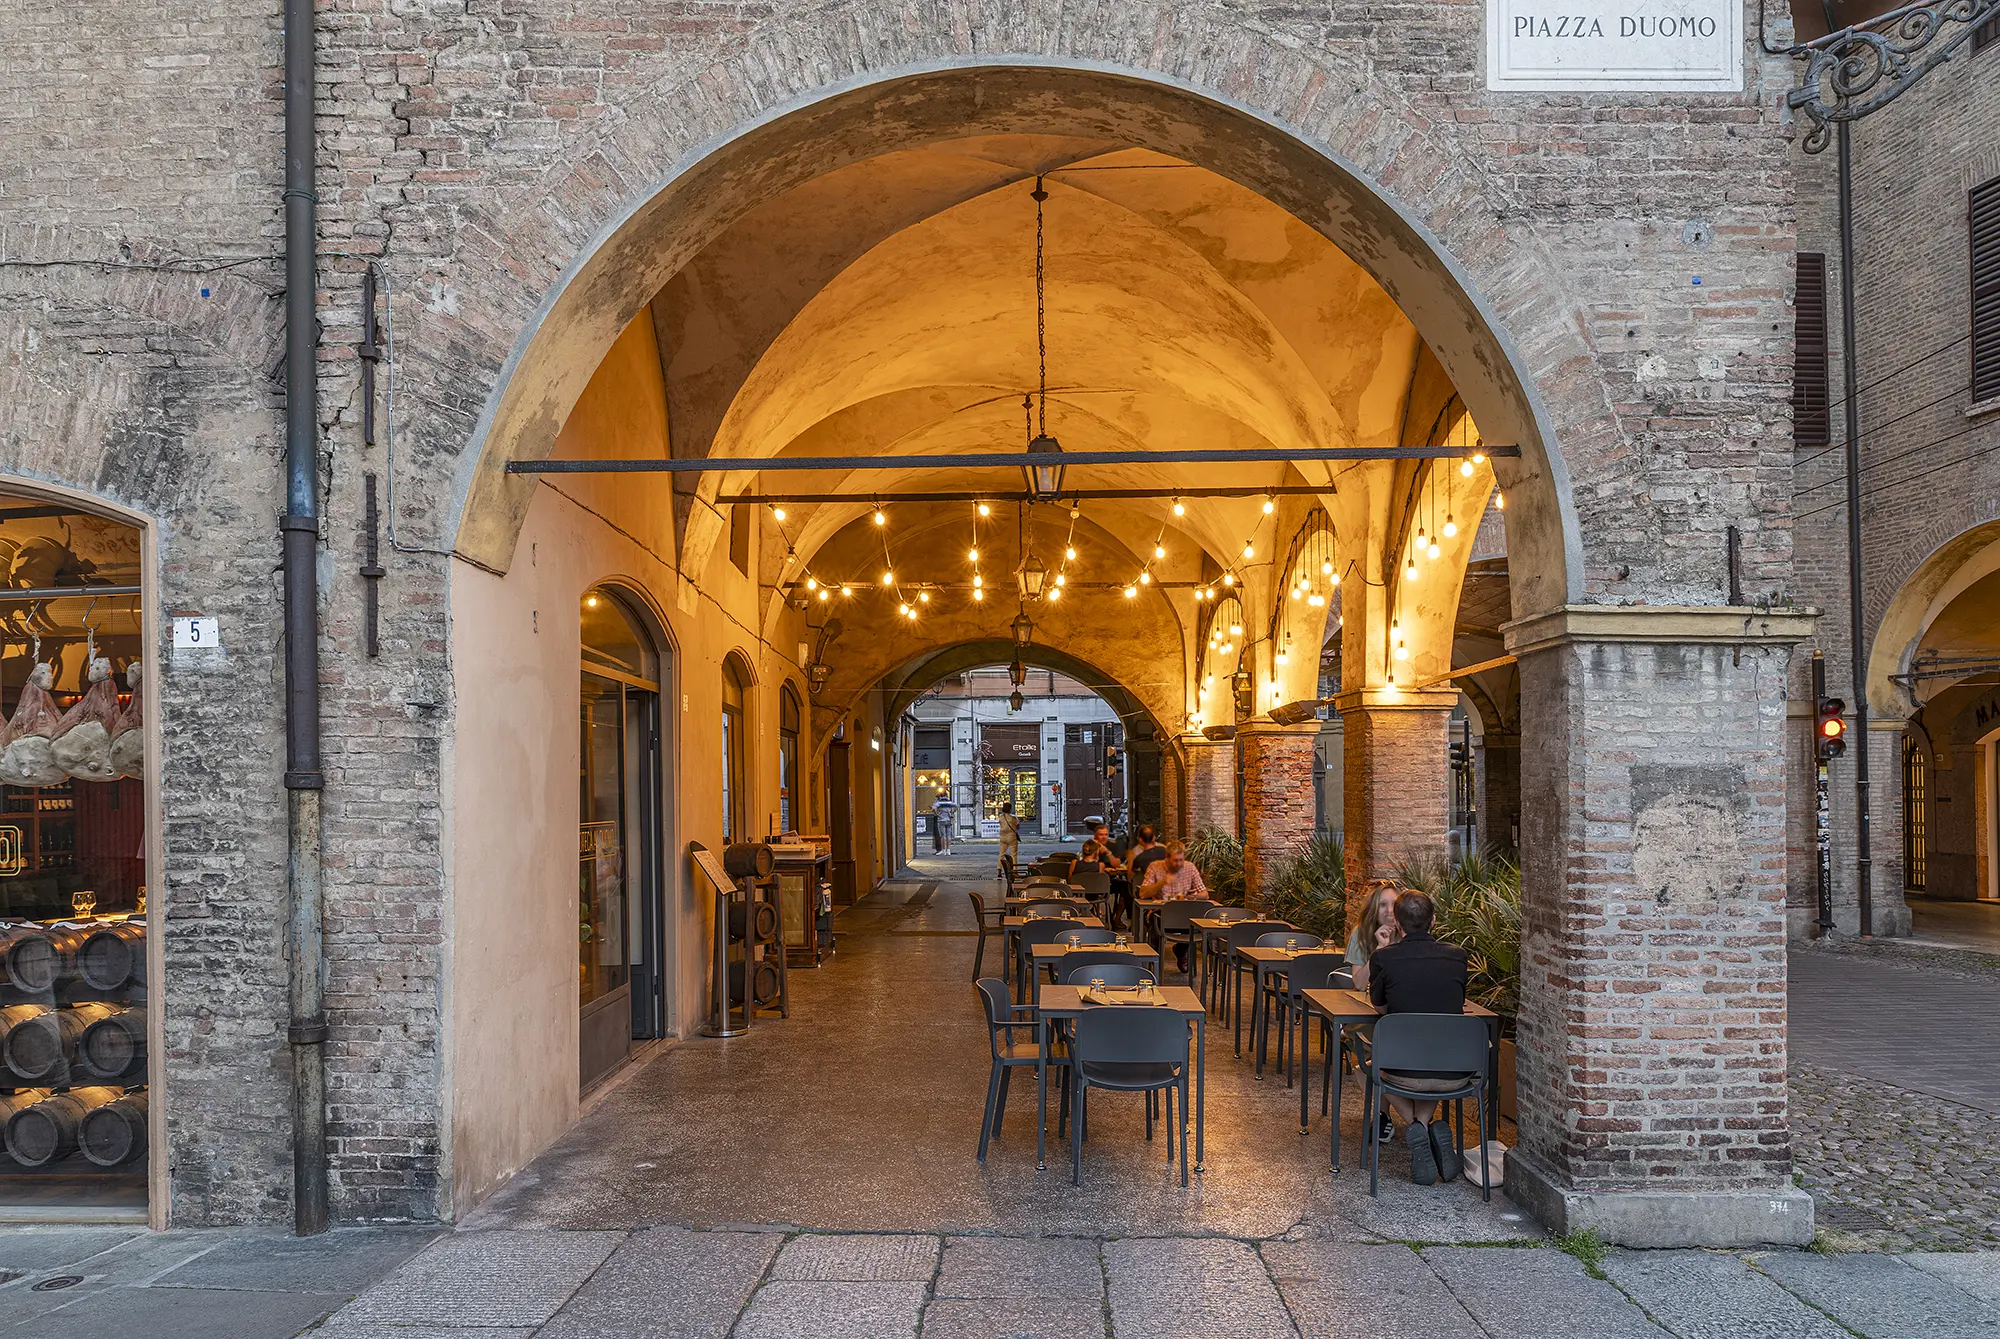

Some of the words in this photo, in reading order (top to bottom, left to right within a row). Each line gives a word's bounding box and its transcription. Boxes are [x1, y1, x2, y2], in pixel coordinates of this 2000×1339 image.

[1514, 16, 1604, 37] PIAZZA
[1620, 16, 1716, 37] DUOMO
[191, 621, 200, 642] 5
